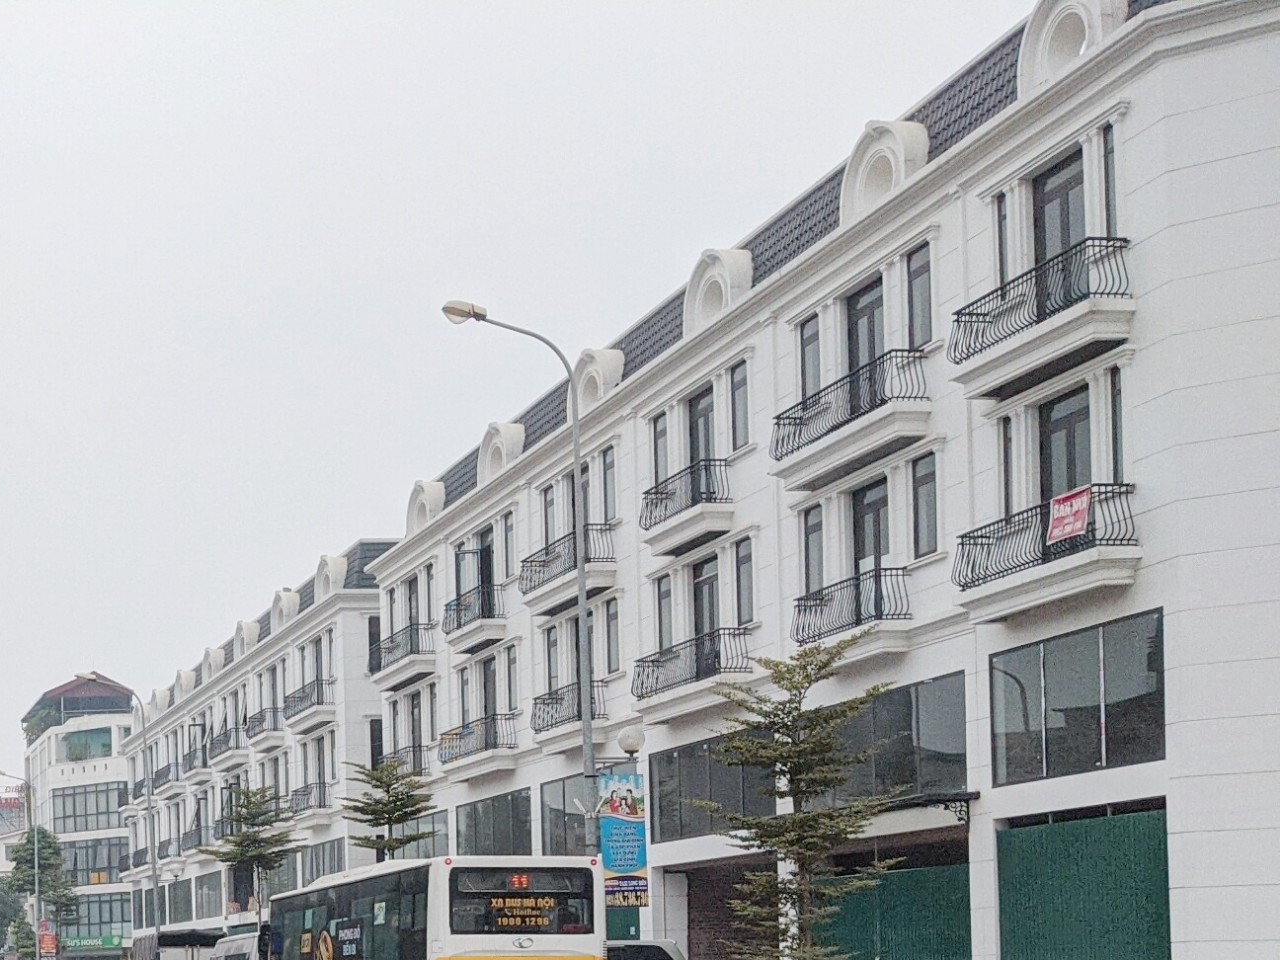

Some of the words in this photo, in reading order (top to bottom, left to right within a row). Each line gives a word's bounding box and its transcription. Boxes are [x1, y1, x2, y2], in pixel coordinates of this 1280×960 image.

[505, 898, 521, 907] BUS
[523, 896, 536, 907] HÀ
[537, 896, 554, 909] NỘI
[513, 908, 541, 916] Hotline
[81, 938, 103, 946] HOUSE
